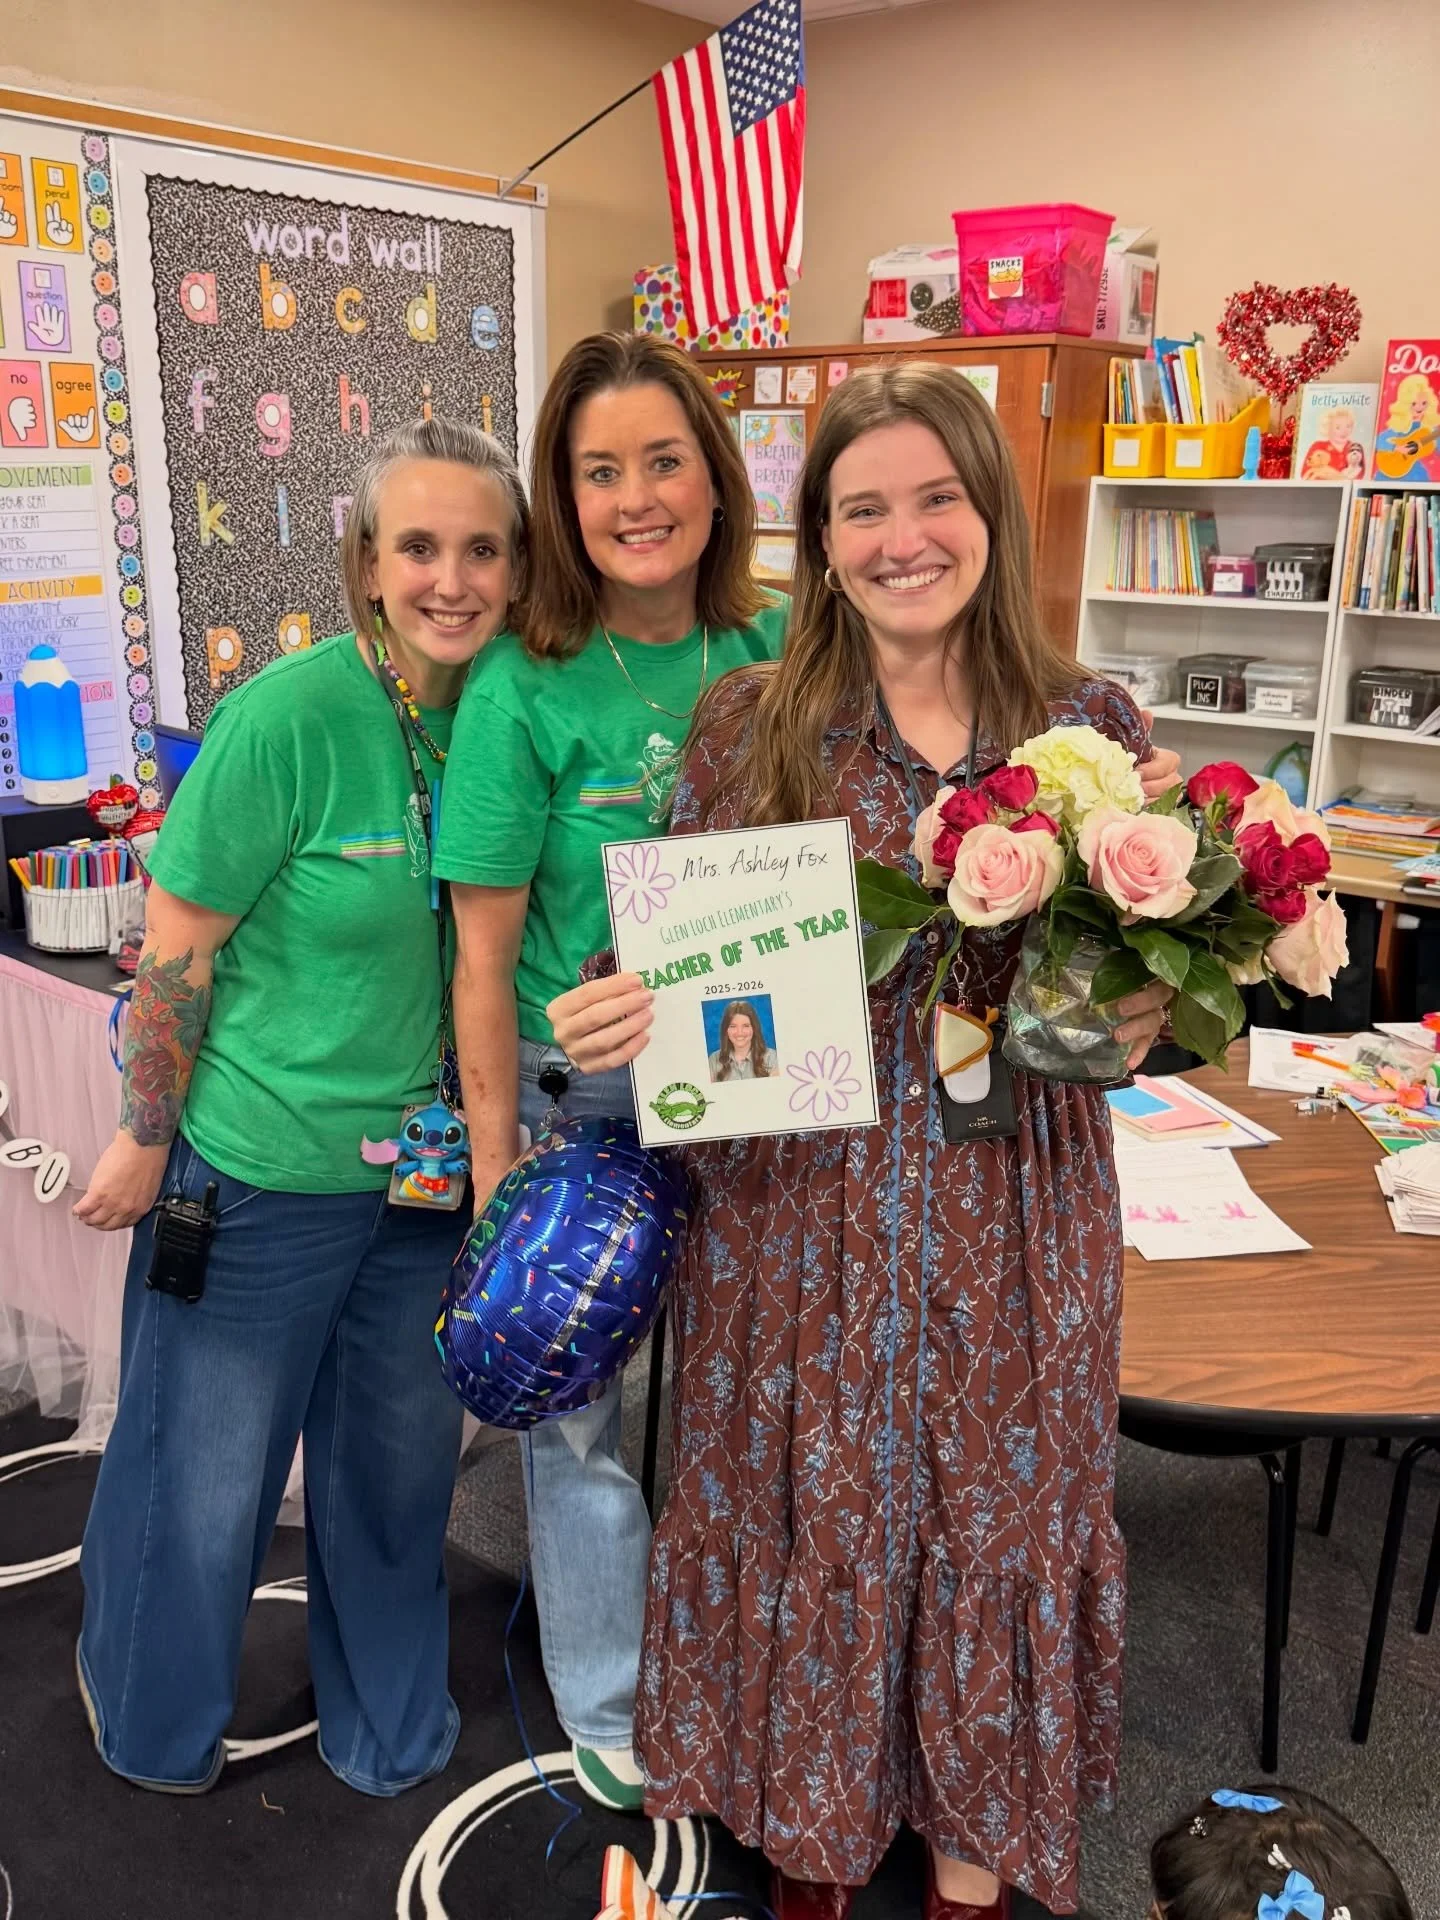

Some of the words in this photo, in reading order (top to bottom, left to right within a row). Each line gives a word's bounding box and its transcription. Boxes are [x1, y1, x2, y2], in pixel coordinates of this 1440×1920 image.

[245, 211, 349, 264] word
[369, 223, 441, 273] wall
[990, 258, 1022, 270] SNACKS
[26, 290, 63, 302] question
[179, 272, 219, 324] a
[259, 263, 297, 330] b
[335, 287, 366, 334] c
[406, 282, 438, 343] d
[471, 305, 499, 349] e
[10, 373, 28, 385] no
[56, 381, 92, 394] agree
[1311, 394, 1338, 408] Betty
[1342, 394, 1371, 407] White
[188, 368, 219, 433] f
[256, 392, 291, 457] g
[338, 374, 371, 436] h
[196, 482, 236, 548] k
[8, 579, 76, 599] ACTIVITY
[1266, 590, 1301, 599] SHARPIES
[205, 626, 243, 689] p
[1192, 679, 1216, 690] PLUG
[1196, 692, 1210, 704] INS
[1374, 687, 1412, 699] BINDER
[682, 856, 721, 881] Mrs.
[729, 845, 789, 881] Ashley
[797, 842, 828, 868] Fox
[637, 952, 714, 991] EACHER
[720, 941, 742, 967] OF
[750, 926, 789, 956] THE
[793, 908, 849, 942] YEAR
[704, 980, 764, 995] 2025-2026
